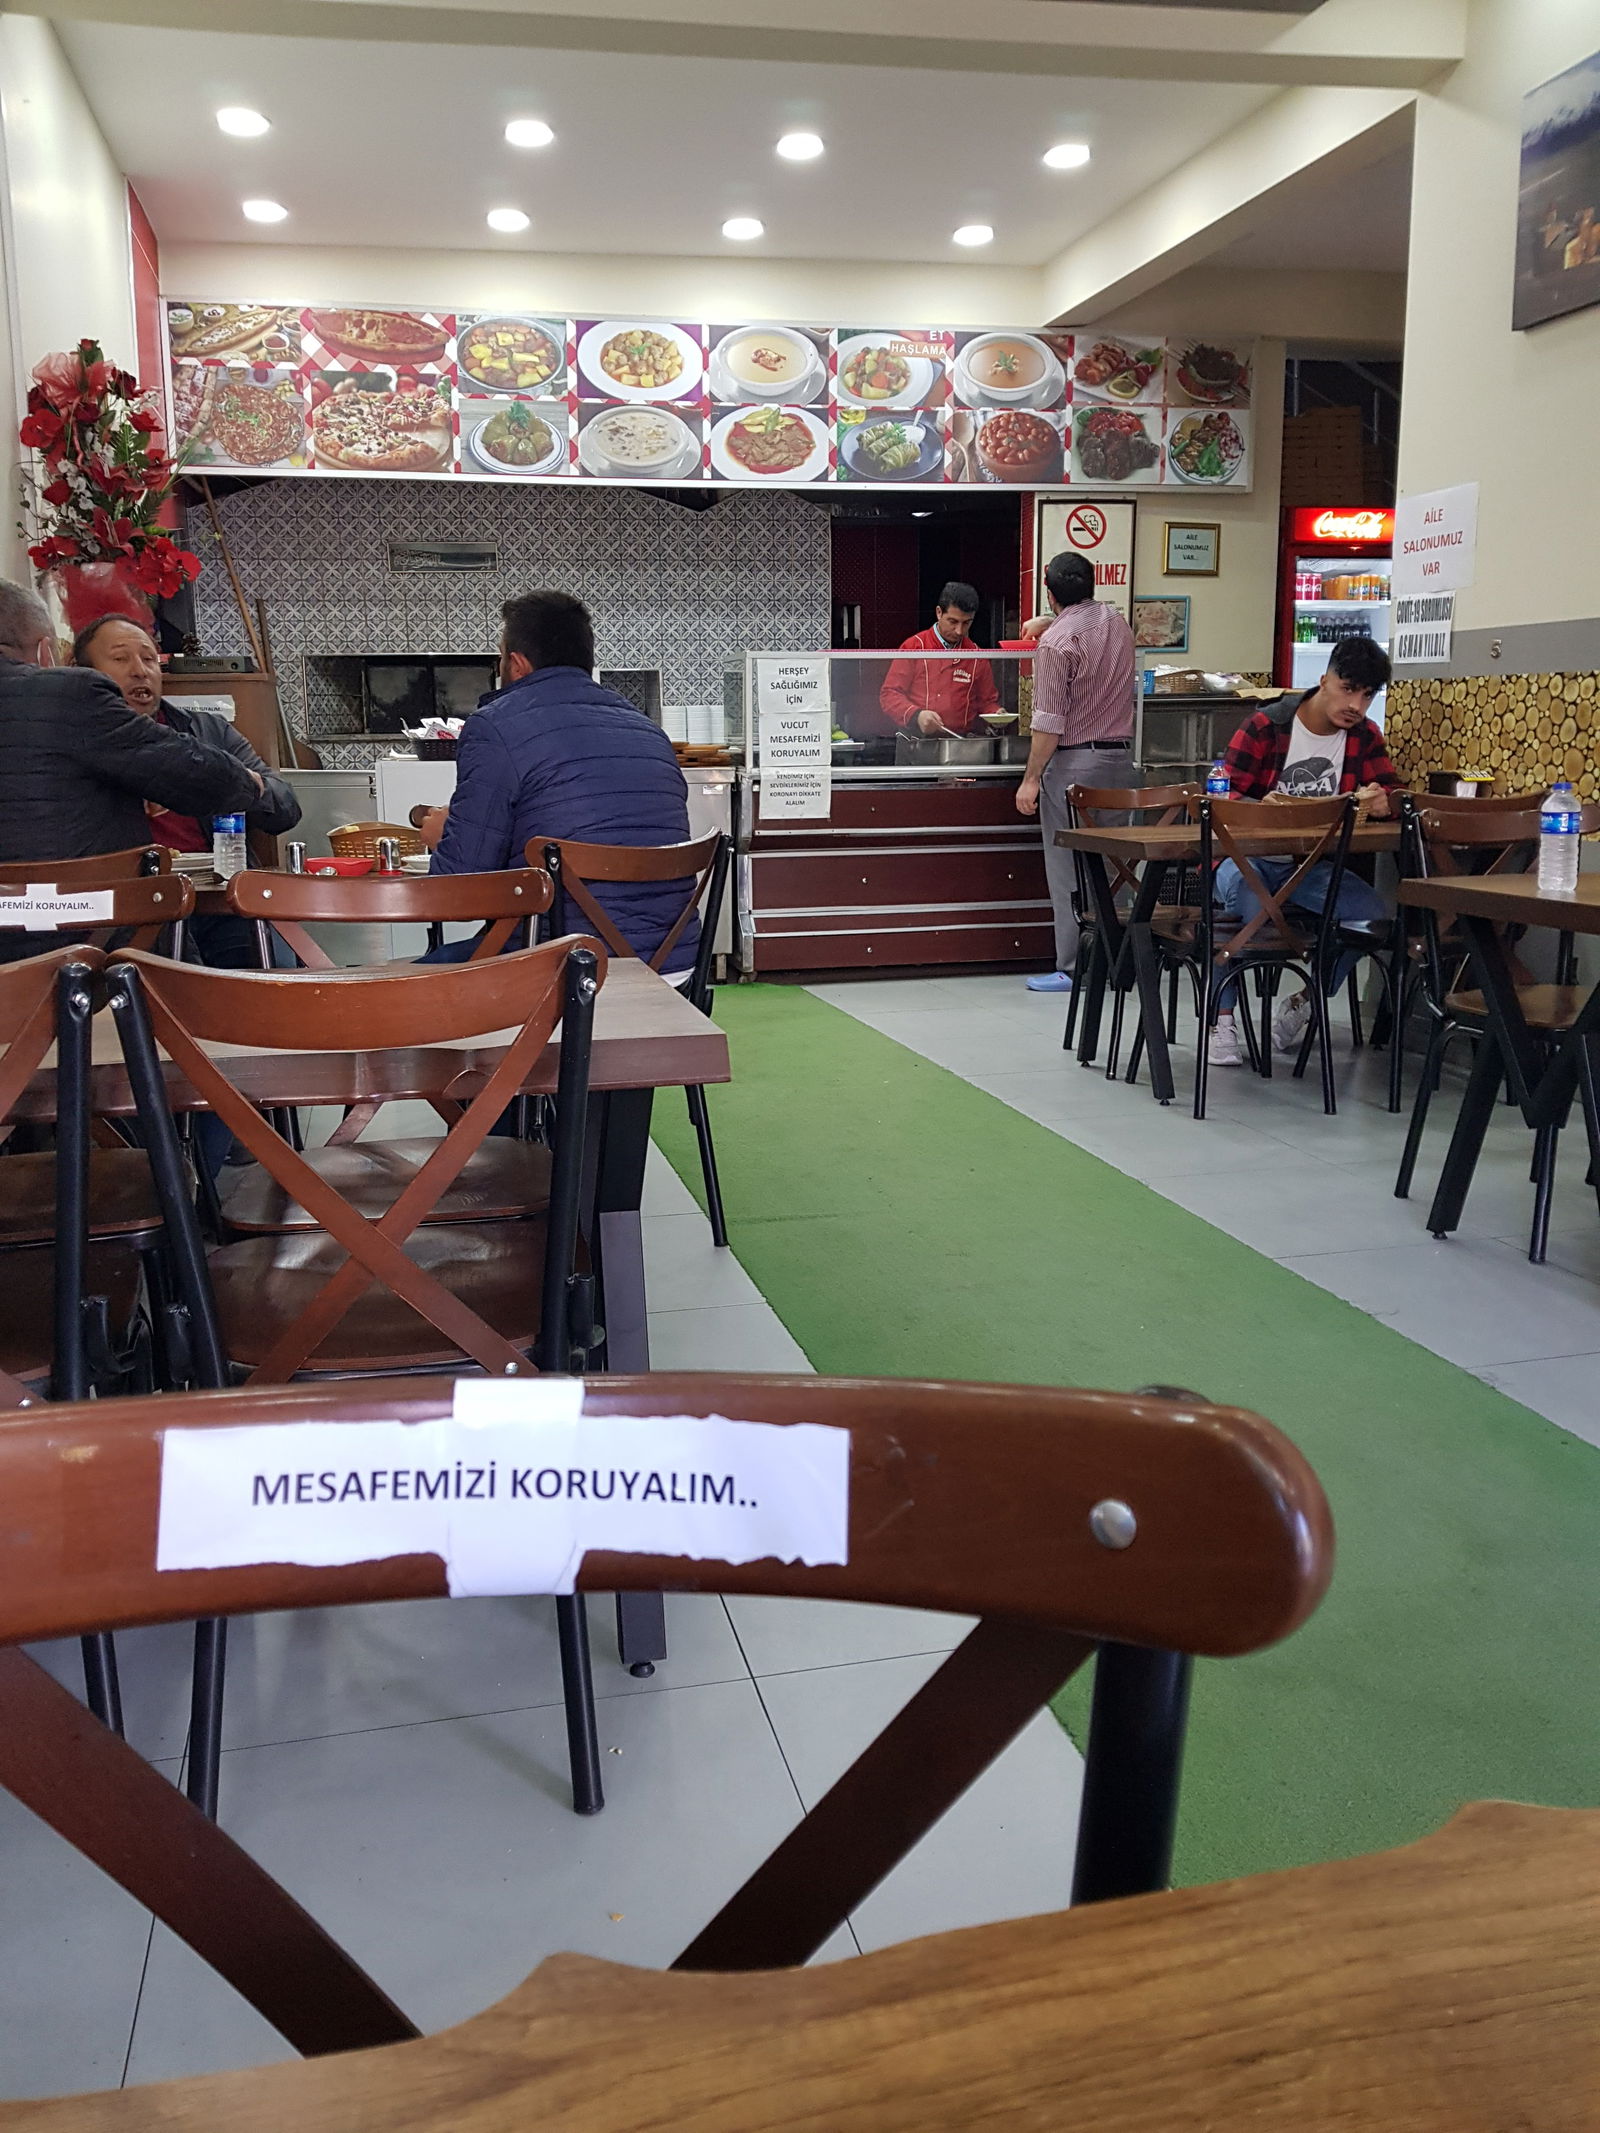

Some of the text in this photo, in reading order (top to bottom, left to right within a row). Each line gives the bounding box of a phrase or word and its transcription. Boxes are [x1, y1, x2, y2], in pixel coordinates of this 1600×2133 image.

[930, 331, 943, 340] ET
[891, 343, 946, 355] HAŞLAMA
[1424, 508, 1444, 525] AİLE
[1404, 531, 1463, 554] SALONUMUZ
[1095, 560, 1127, 586] İLMEZ
[1423, 561, 1440, 576] VAR
[1399, 633, 1446, 658] OSMAN YILDIZ
[778, 667, 809, 676] HERŞEY
[770, 680, 818, 690] SAĞLIĞIMIZ
[786, 694, 803, 705] İÇİN
[781, 721, 809, 729] VUCUT
[769, 733, 821, 743] MESAFEMİZİ
[771, 749, 820, 757] KORUYALIM
[0, 901, 33, 910] FEMİZİ
[252, 1460, 759, 1508] MESAFEMİZİ KORUYALIM..
